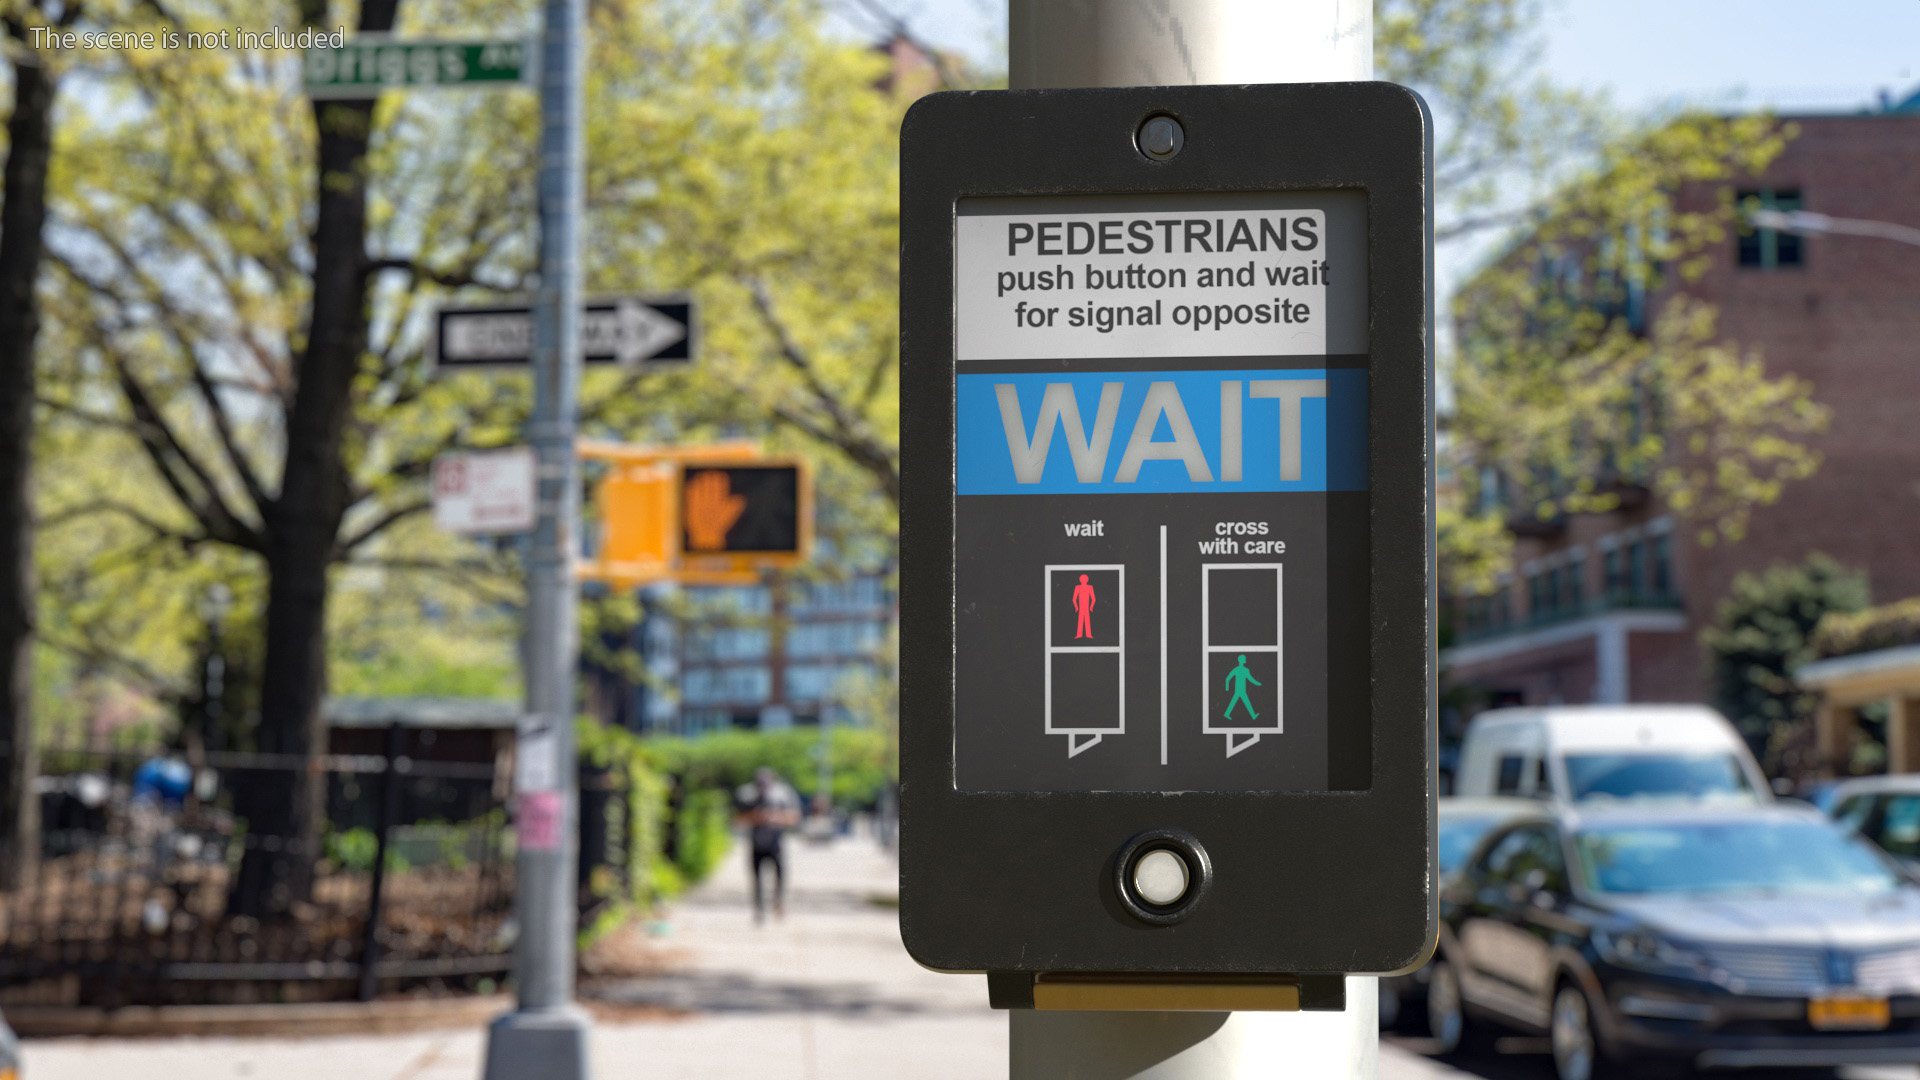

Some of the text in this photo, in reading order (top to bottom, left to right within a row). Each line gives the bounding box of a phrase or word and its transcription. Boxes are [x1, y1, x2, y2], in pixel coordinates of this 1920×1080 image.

[1008, 216, 1319, 256] PEDESTRIANS
[998, 260, 1331, 297] push button and wait
[1015, 297, 1311, 334] for signal opposite
[994, 379, 1331, 484] WAIT
[1064, 520, 1105, 537] wait
[1198, 537, 1286, 555] with care
[1215, 521, 1270, 536] cross
